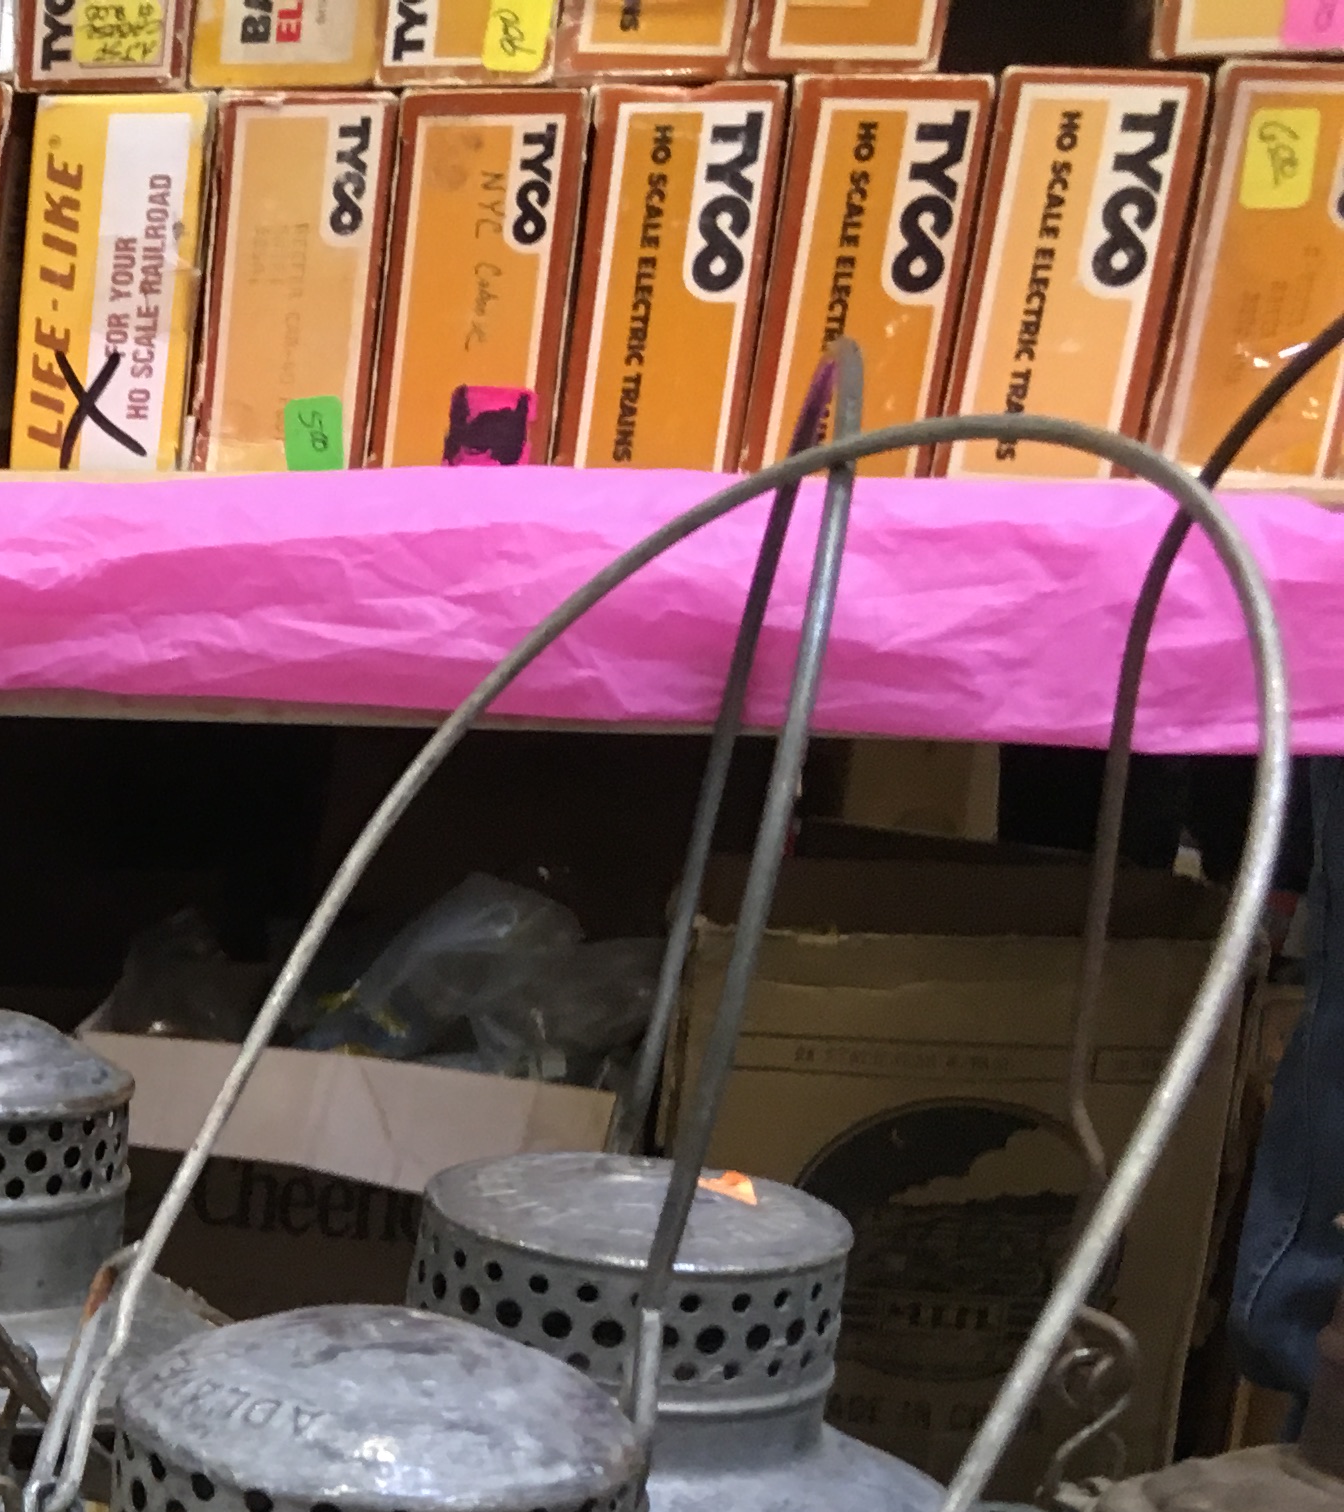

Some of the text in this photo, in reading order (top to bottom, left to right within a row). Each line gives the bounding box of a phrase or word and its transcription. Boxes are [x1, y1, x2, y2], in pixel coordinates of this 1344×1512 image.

[392, 0, 428, 62] TY
[329, 116, 372, 237] TYCO
[512, 122, 559, 246] TYCO
[691, 110, 764, 293] TYCO
[822, 121, 879, 351] HO SCALE ELECTR
[890, 110, 972, 293] TYCO
[1091, 100, 1179, 288] TYCO
[103, 237, 138, 359] FOR YOUR
[126, 174, 171, 421] HO SCALE RAILROAD
[612, 124, 675, 464] HO SCALE ELECTRIC TRAINS
[995, 110, 1083, 462] HO SCALE ELECTRIC TRAS
